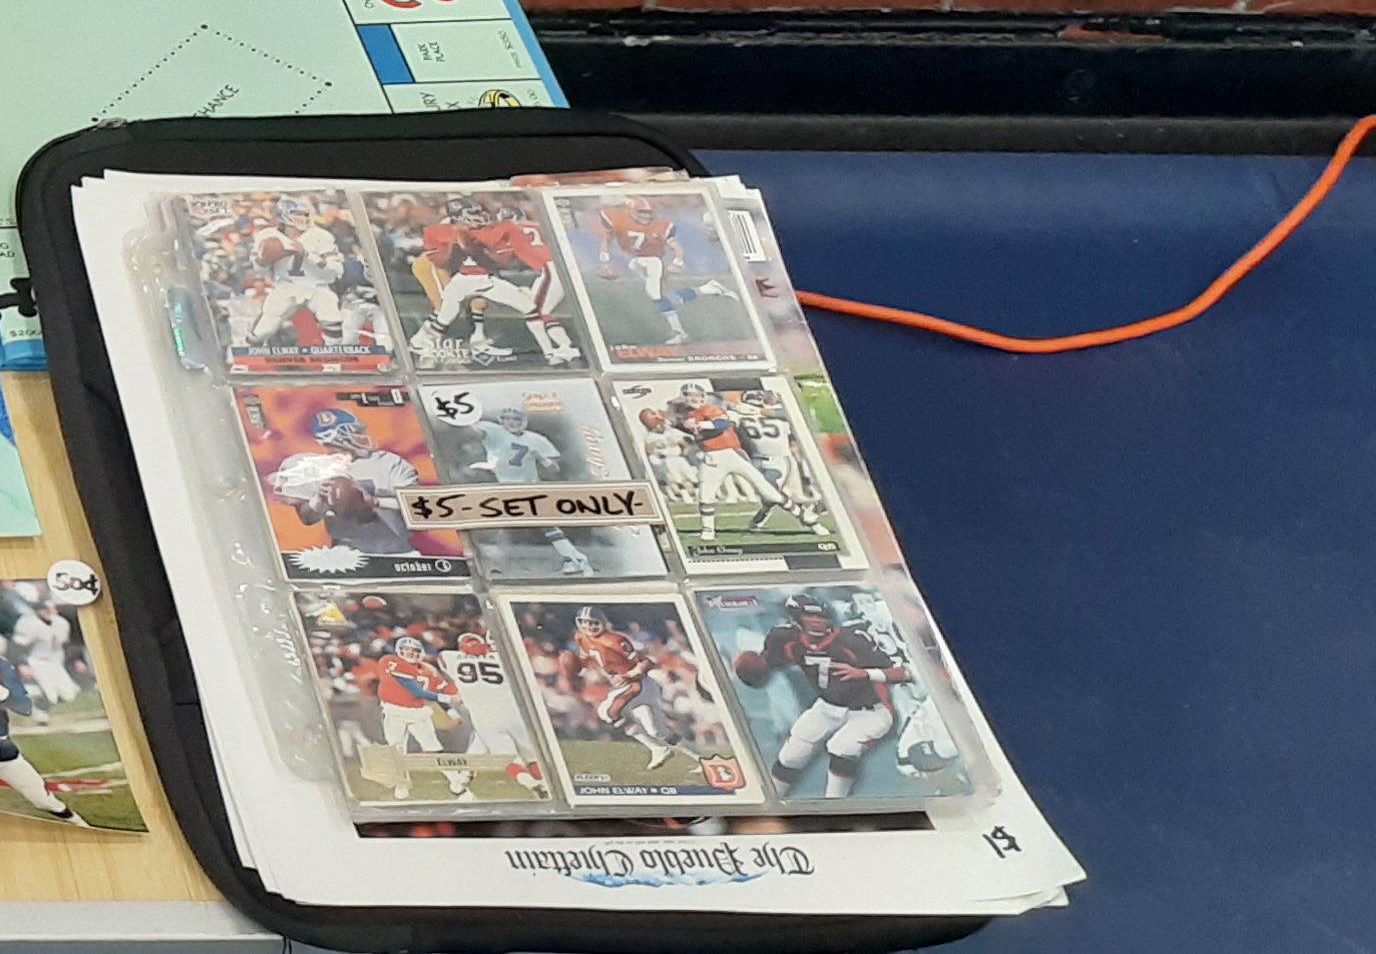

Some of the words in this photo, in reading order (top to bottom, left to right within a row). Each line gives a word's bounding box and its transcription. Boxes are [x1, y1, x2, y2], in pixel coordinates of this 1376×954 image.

[192, 84, 240, 118] HANCE
[434, 392, 476, 419] $5
[480, 494, 550, 517] SET
[53, 573, 100, 594] 50¢
[457, 662, 504, 685] 95
[504, 843, 634, 878] Chieftain
[640, 842, 748, 878] Pueblo
[752, 842, 815, 877] The
